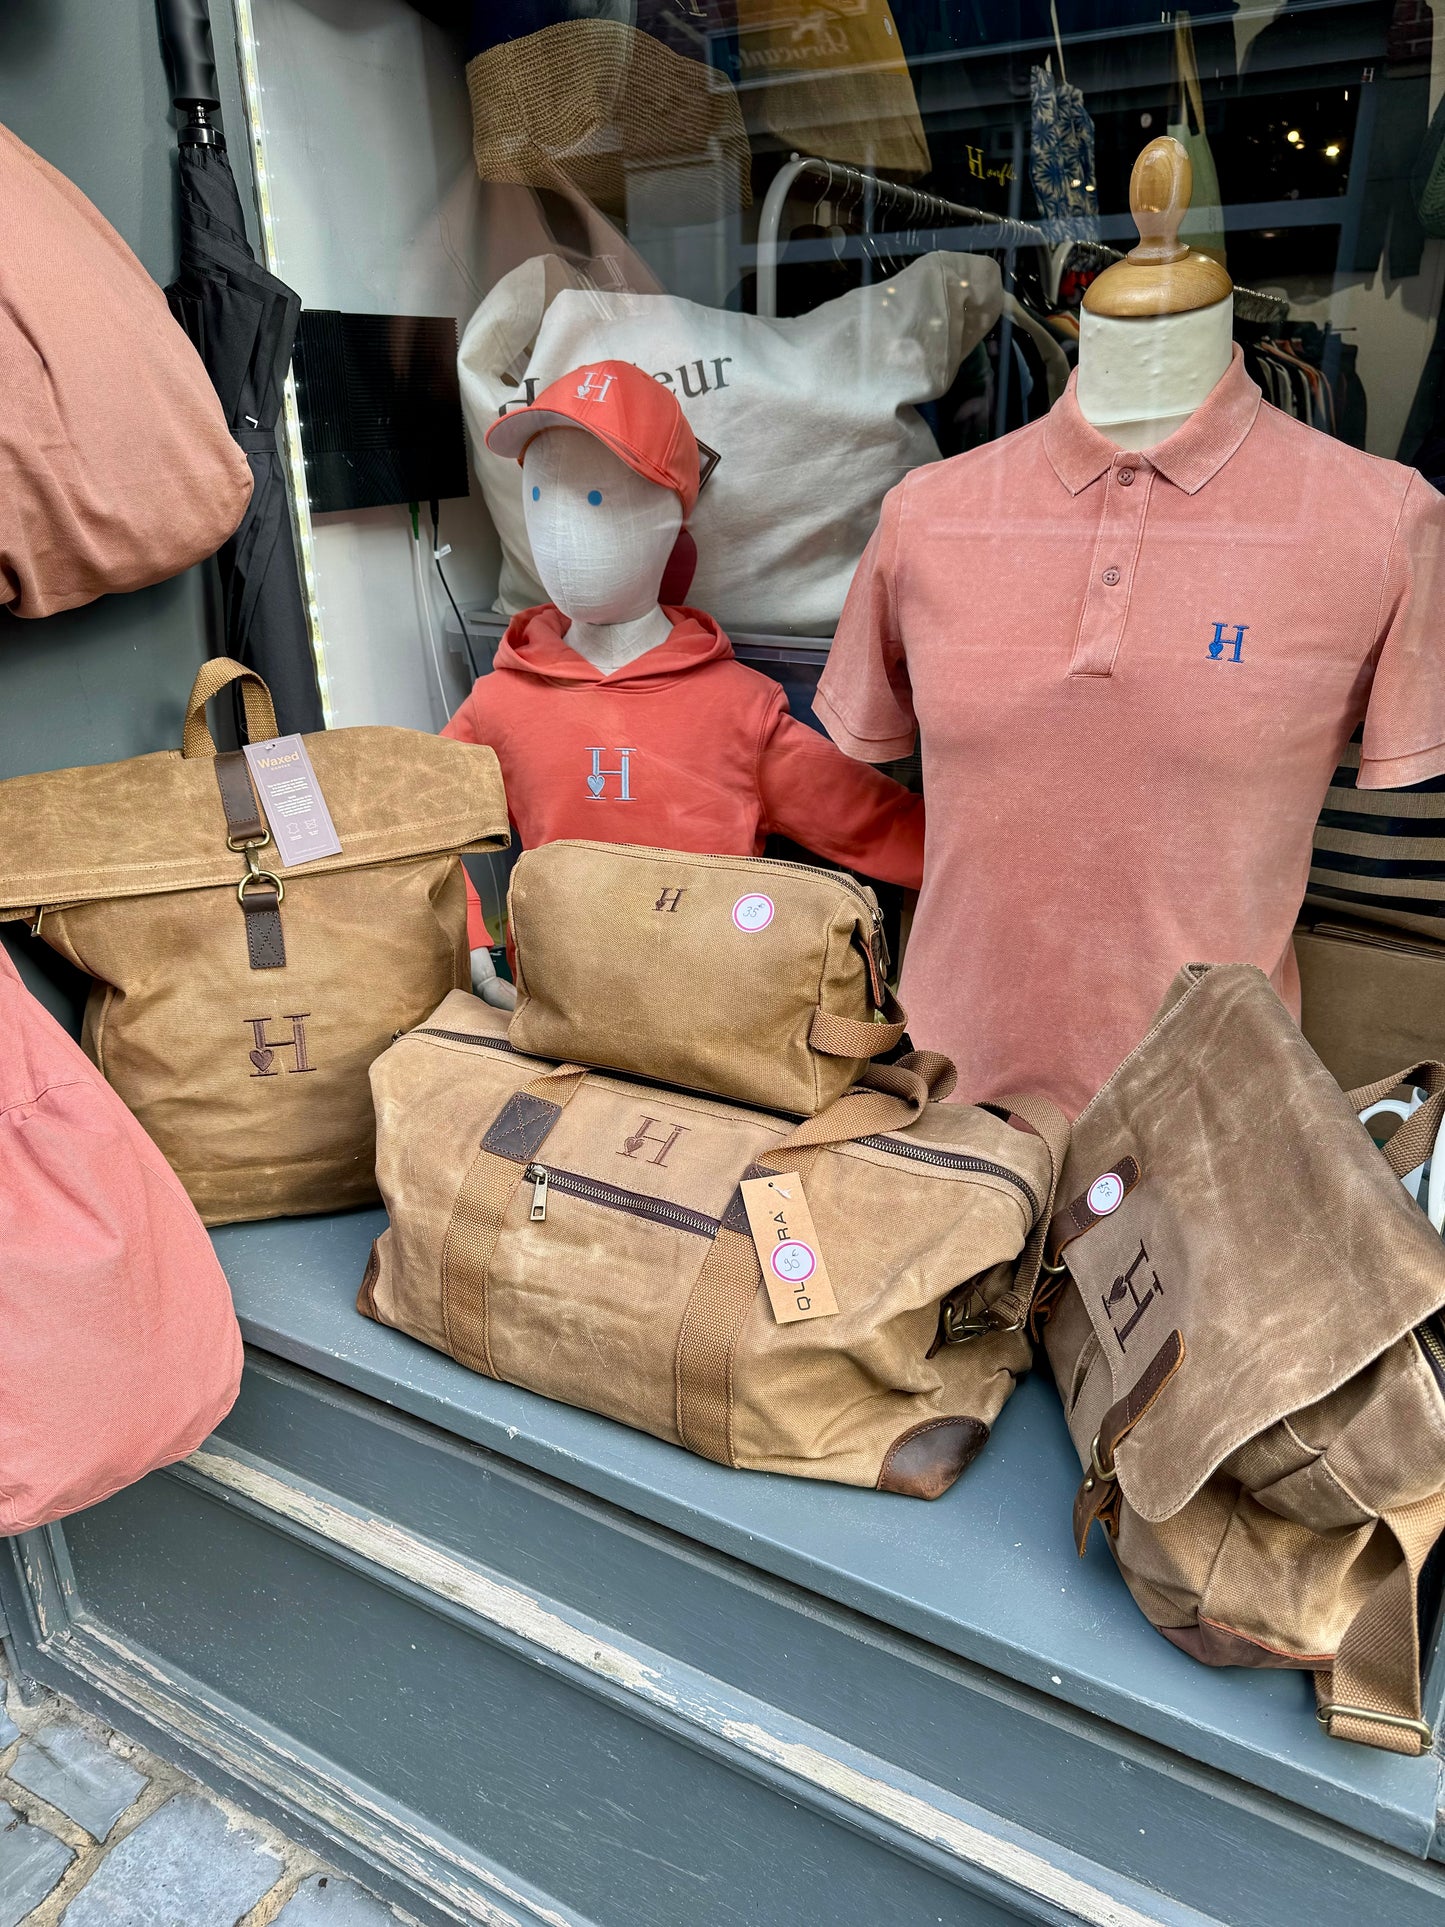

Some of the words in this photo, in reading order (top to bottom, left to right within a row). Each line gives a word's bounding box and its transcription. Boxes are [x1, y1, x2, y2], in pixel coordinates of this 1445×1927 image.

[573, 371, 618, 403] H
[1205, 621, 1250, 664] H
[257, 751, 300, 769] Waxed
[583, 746, 637, 801] H
[651, 887, 688, 913] H
[243, 1012, 317, 1077] H
[615, 1114, 693, 1168] H
[1101, 1238, 1164, 1354] H
